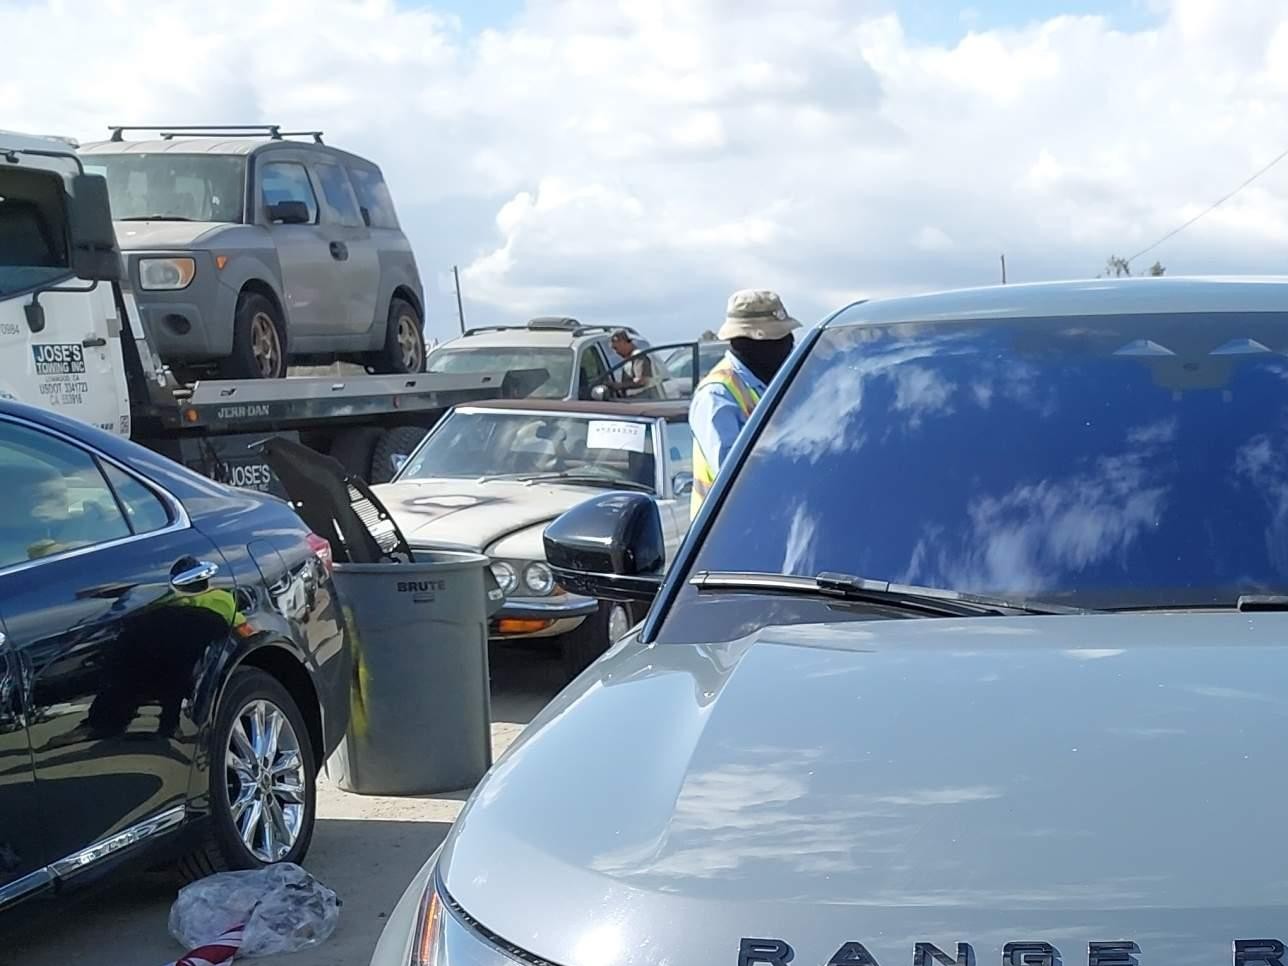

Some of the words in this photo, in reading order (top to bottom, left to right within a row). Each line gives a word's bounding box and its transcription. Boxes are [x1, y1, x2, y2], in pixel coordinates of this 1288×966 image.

[37, 345, 81, 362] JOSE'S
[230, 464, 271, 486] JOSE'S
[397, 580, 447, 592] BRUTE
